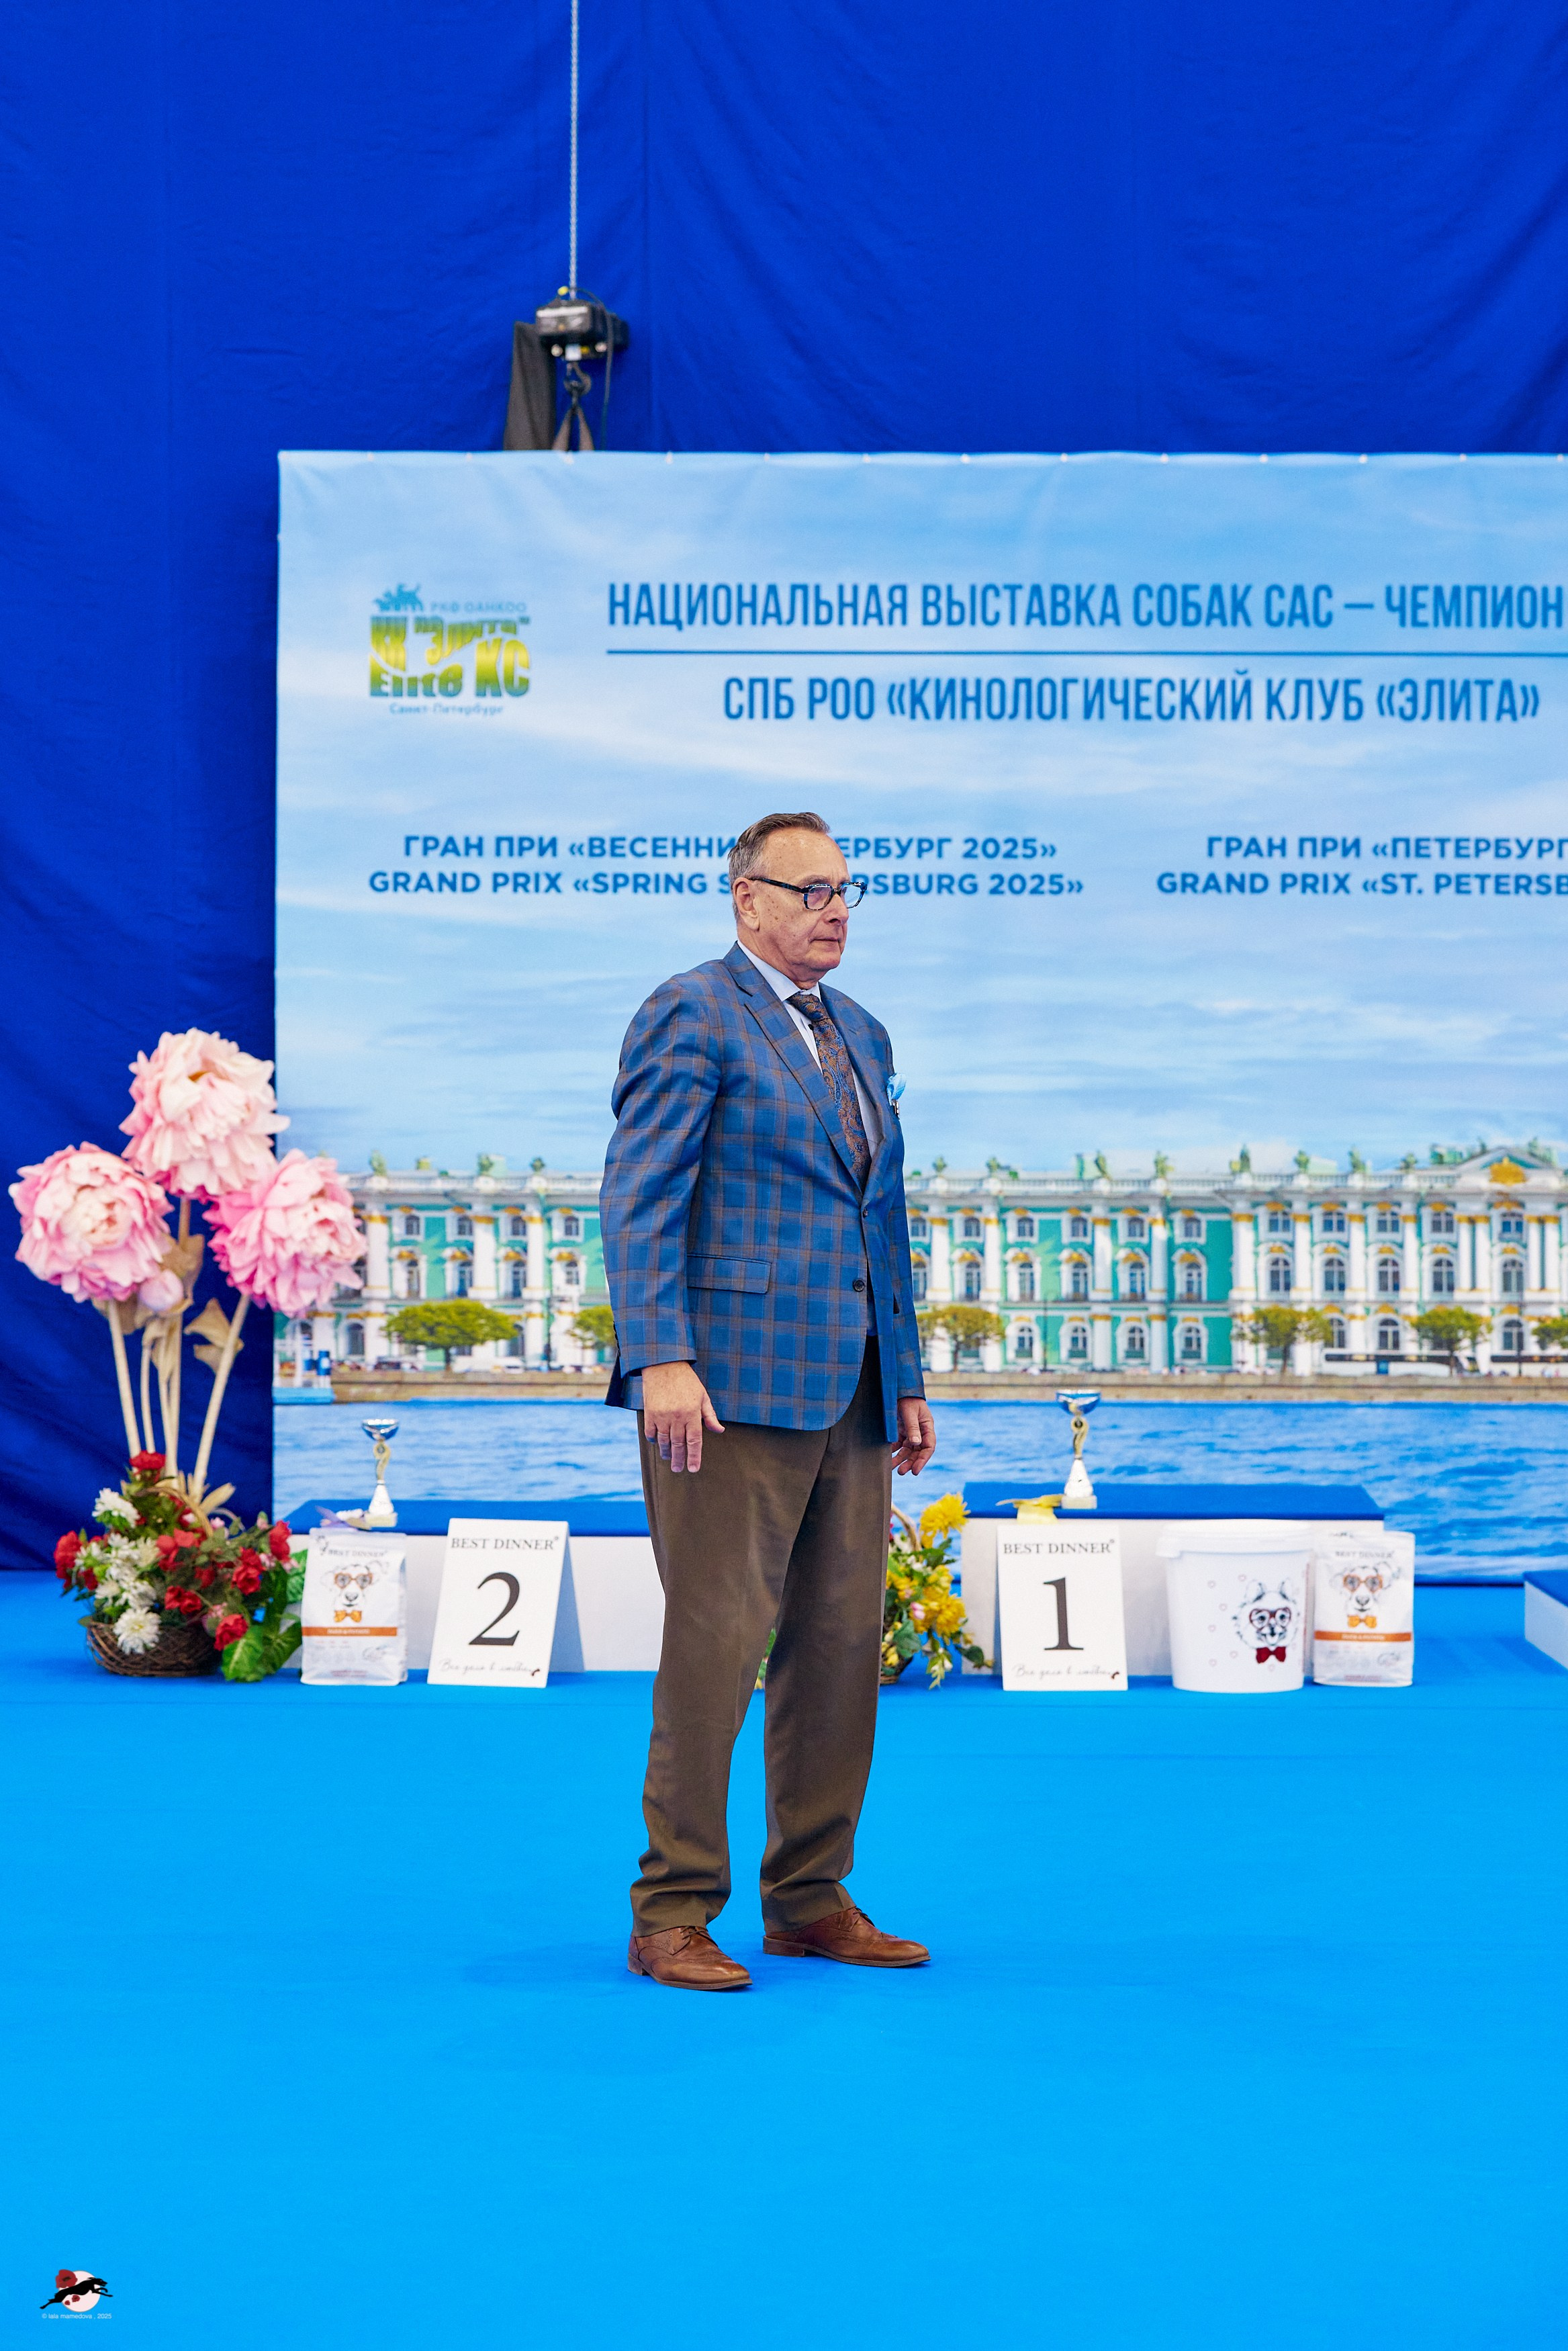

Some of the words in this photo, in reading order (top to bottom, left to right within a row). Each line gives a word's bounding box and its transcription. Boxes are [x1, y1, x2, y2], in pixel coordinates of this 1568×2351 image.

[608, 582, 909, 632] НАЦИОНАЛЬНАЯ
[921, 582, 1121, 627] ВЫСТАВКА
[1132, 582, 1252, 628] СОБАК
[723, 676, 796, 721] СПБ
[807, 676, 876, 721] РОО
[886, 668, 1252, 723] «КИНОЛОГИЧЕСКИЙ
[1266, 676, 1365, 722] КЛУБ
[1376, 677, 1541, 723] «ЭЛИТА»
[404, 834, 485, 858] ГРАН
[494, 835, 559, 859] ПРИ
[567, 835, 737, 860] «ВЕСЕННИ
[962, 837, 1058, 861] 2025»
[1207, 836, 1287, 859] ГРАН
[1297, 836, 1362, 859] ПРИ
[368, 870, 482, 894] GRAND
[492, 871, 563, 894] PRIX
[572, 871, 708, 895] «SPRING
[988, 873, 1085, 896] 2025»
[1156, 871, 1270, 895] GRAND
[1280, 872, 1351, 895] PRIX
[1361, 872, 1424, 895] «ST.
[451, 1537, 490, 1549] BEST
[1003, 1542, 1043, 1554] BEST
[468, 1571, 520, 1646] 2
[1043, 1576, 1085, 1650] 1
